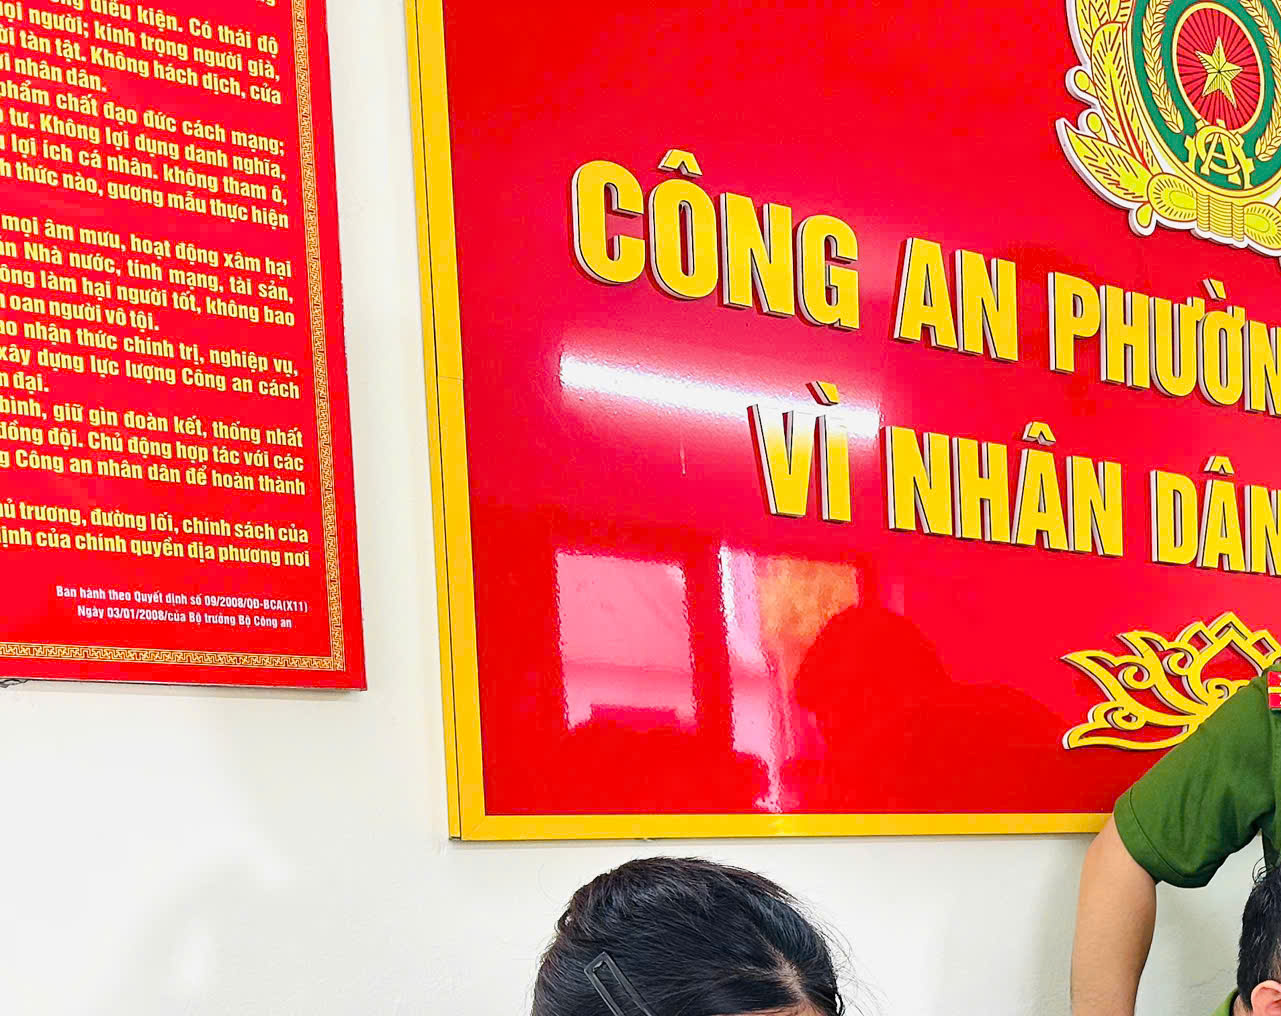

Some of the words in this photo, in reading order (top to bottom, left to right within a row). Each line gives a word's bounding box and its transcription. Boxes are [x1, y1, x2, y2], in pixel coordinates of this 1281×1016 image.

[28, 7, 88, 38] người;
[93, 20, 135, 47] kính
[139, 31, 188, 61] trọng
[193, 47, 242, 71] người
[247, 58, 280, 82] già,
[137, 4, 183, 32] kiện.
[188, 17, 212, 39] Có
[217, 24, 251, 48] thái
[257, 34, 278, 58] độ
[19, 29, 51, 54] tàn
[54, 37, 86, 62] tật.
[90, 45, 149, 78] Không
[153, 59, 198, 86] hách
[201, 71, 246, 99] dịch,
[249, 82, 281, 104] cửa
[55, 92, 98, 117] chất
[103, 101, 137, 125] đạo
[143, 109, 176, 132] đức
[182, 119, 225, 142] cách
[231, 130, 284, 156] mạng;
[1, 214, 38, 237] mọi
[44, 218, 74, 241] âm
[79, 228, 126, 252] mưu,
[130, 233, 171, 259] hoạt
[175, 242, 218, 267] động
[223, 251, 260, 272] xâm
[265, 256, 291, 280] hại
[23, 241, 62, 265] Nhà
[69, 251, 121, 276] nước,
[127, 259, 162, 281] tính
[168, 268, 224, 293] mạng,
[229, 275, 252, 295] tài
[257, 279, 293, 304] sản,
[570, 149, 860, 330] CÔNG
[893, 237, 1019, 362] AN
[40, 269, 77, 293] làm
[81, 276, 111, 301] hại
[116, 285, 167, 307] người
[171, 290, 201, 314] tốt,
[205, 295, 259, 322] không
[263, 305, 294, 326] bao
[47, 427, 83, 450] đội.
[87, 431, 123, 452] Chủ
[127, 435, 172, 459] động
[175, 440, 208, 463] hợp
[212, 445, 240, 464] tác
[243, 449, 269, 467] với
[273, 453, 303, 471] các
[53, 402, 83, 422] giữ
[88, 406, 118, 426] gìn
[123, 410, 168, 432] đoàn
[173, 415, 207, 438] kết,
[211, 420, 260, 444] thống
[265, 427, 303, 447] nhất
[747, 379, 853, 524] VÌ
[884, 421, 1124, 558] NHÂN
[19, 501, 86, 526] trương,
[90, 507, 146, 531] đường
[150, 511, 178, 534] lối,
[182, 516, 231, 536] chính
[234, 521, 274, 540] sách
[278, 523, 308, 543] của
[35, 527, 71, 548] của
[74, 532, 126, 552] chính
[130, 536, 184, 557] quyền
[187, 541, 215, 562] địa
[218, 544, 280, 566] phương
[284, 550, 309, 567] nơi
[55, 585, 76, 597] Ban
[79, 586, 105, 599] hành
[108, 589, 131, 601] theo
[133, 590, 162, 603] Quyết
[77, 605, 104, 619] Ngày
[188, 611, 201, 625] Bộ
[238, 614, 251, 628] Bộ
[253, 615, 277, 628] Công
[280, 618, 292, 628] an
